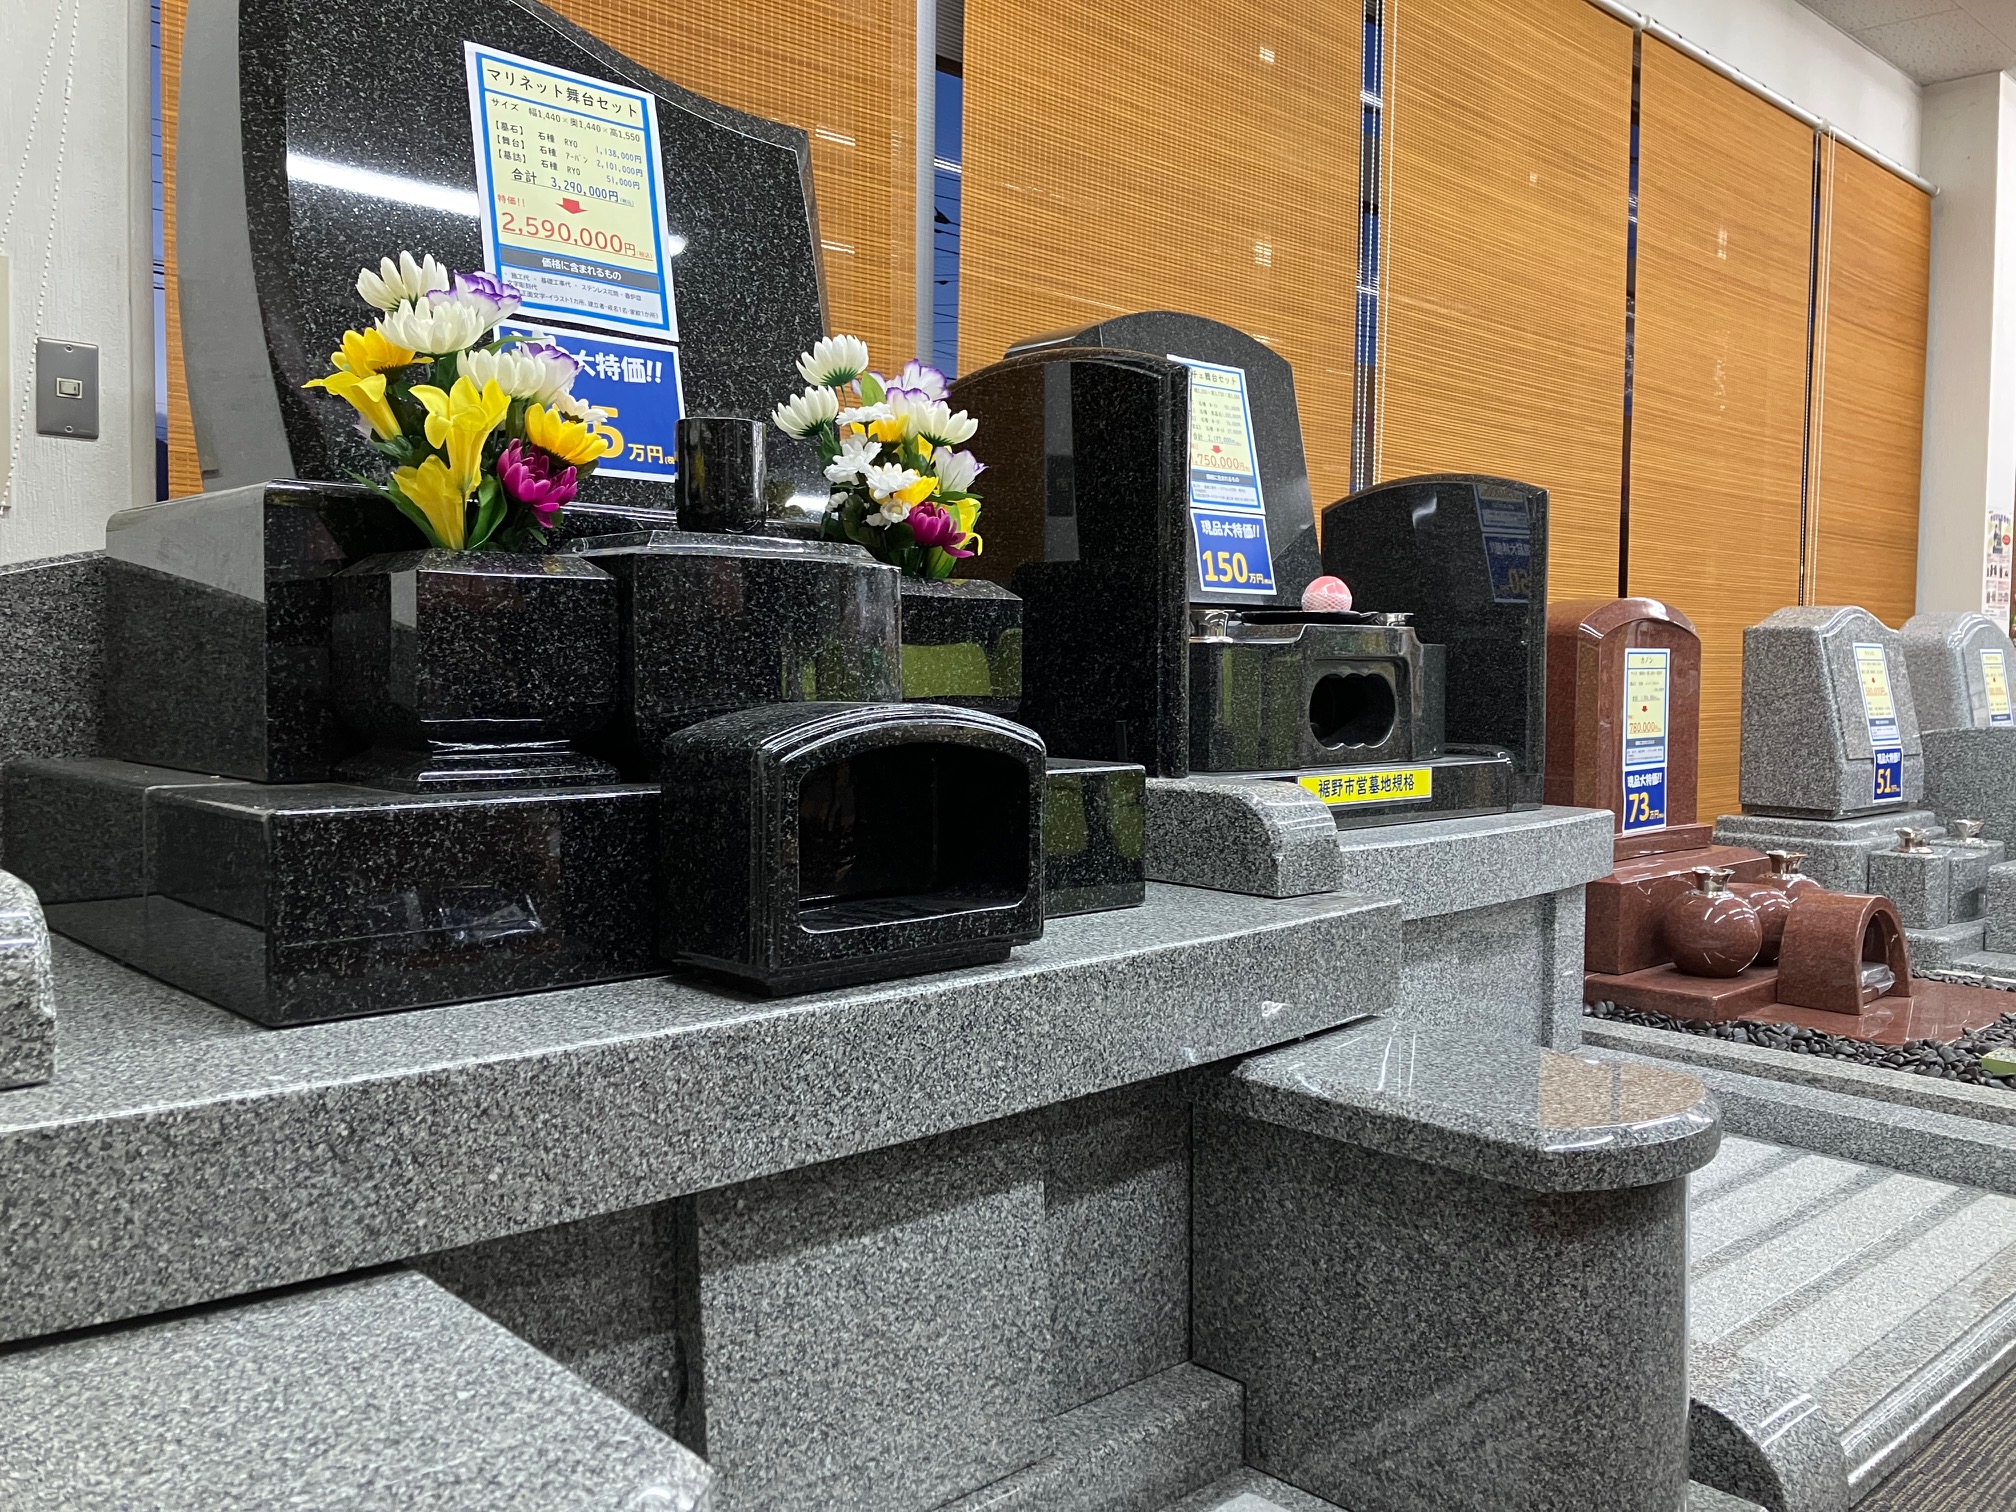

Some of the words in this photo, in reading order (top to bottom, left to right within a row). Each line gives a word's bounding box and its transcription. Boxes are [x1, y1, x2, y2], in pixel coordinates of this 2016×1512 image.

[486, 68, 637, 118] マリネット舞台セット
[491, 97, 519, 112] サイズ
[511, 167, 537, 185] 合計
[497, 194, 526, 208] 特価!!
[541, 257, 622, 281] 価格に含まれるもの
[1192, 370, 1236, 386] チェ舞台セット
[1200, 520, 1260, 539] 現品大特価!!
[1318, 773, 1415, 799] 裾野市営墓地規格
